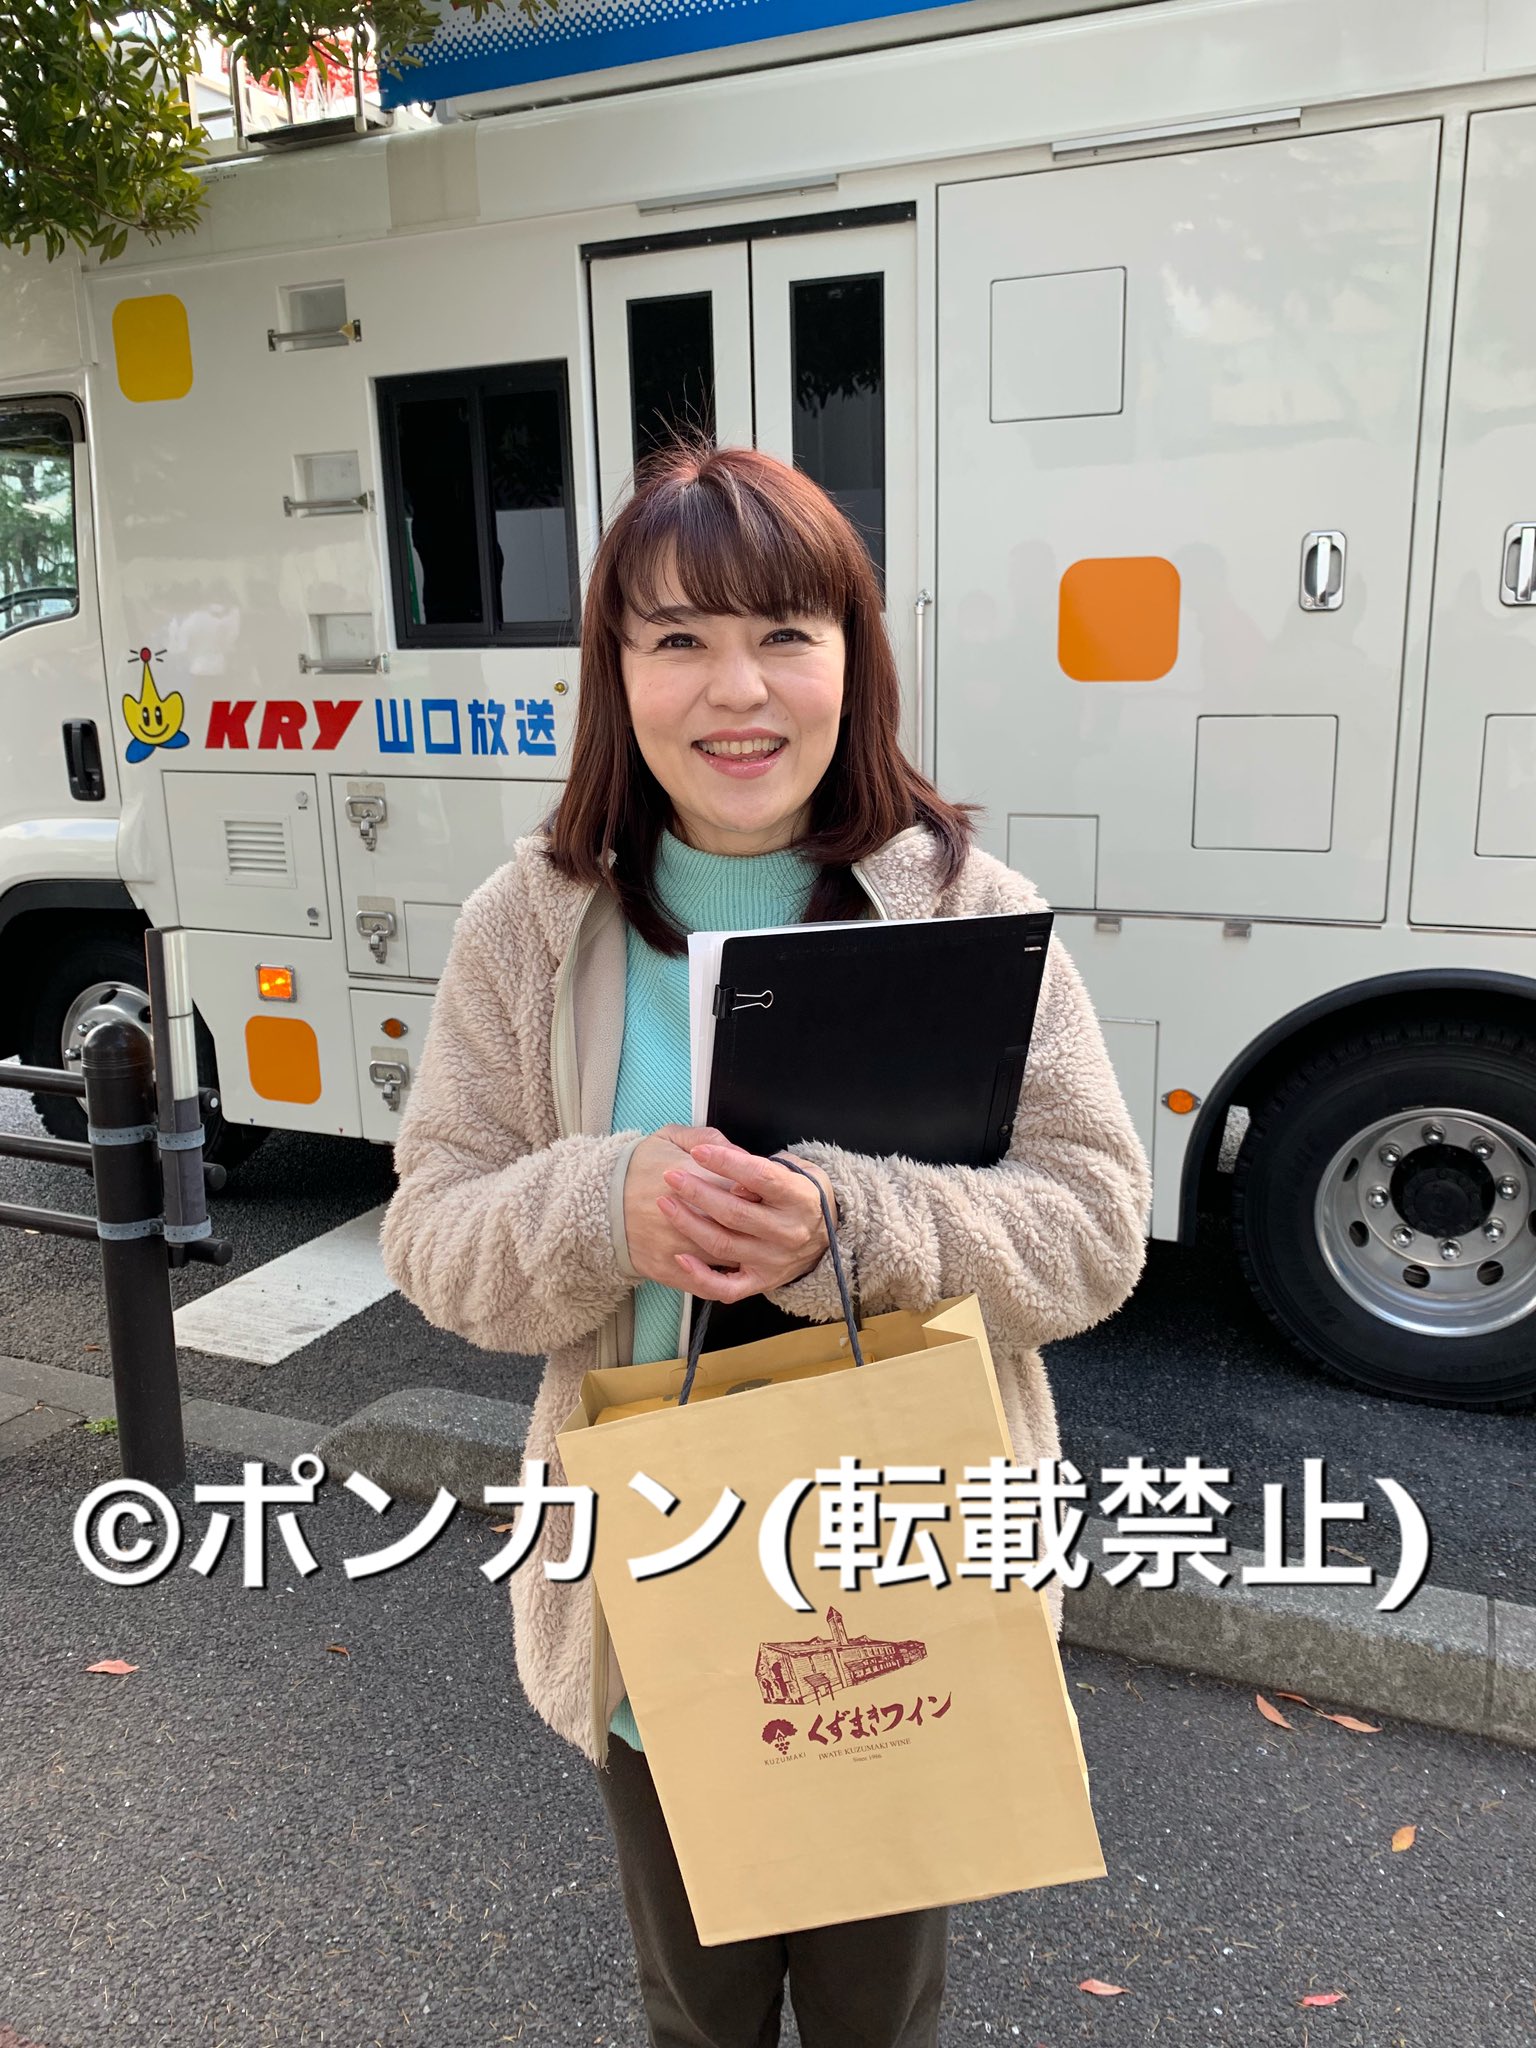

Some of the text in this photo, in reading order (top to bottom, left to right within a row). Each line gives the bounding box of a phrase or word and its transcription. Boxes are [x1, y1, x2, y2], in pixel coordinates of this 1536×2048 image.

[205, 698, 557, 756] KRY 山口放送
[807, 1691, 952, 1745] くずまきワイン
[764, 1752, 807, 1766] KUZUMAKI
[818, 1737, 912, 1760] IWATE KUZUMAKI WINE
